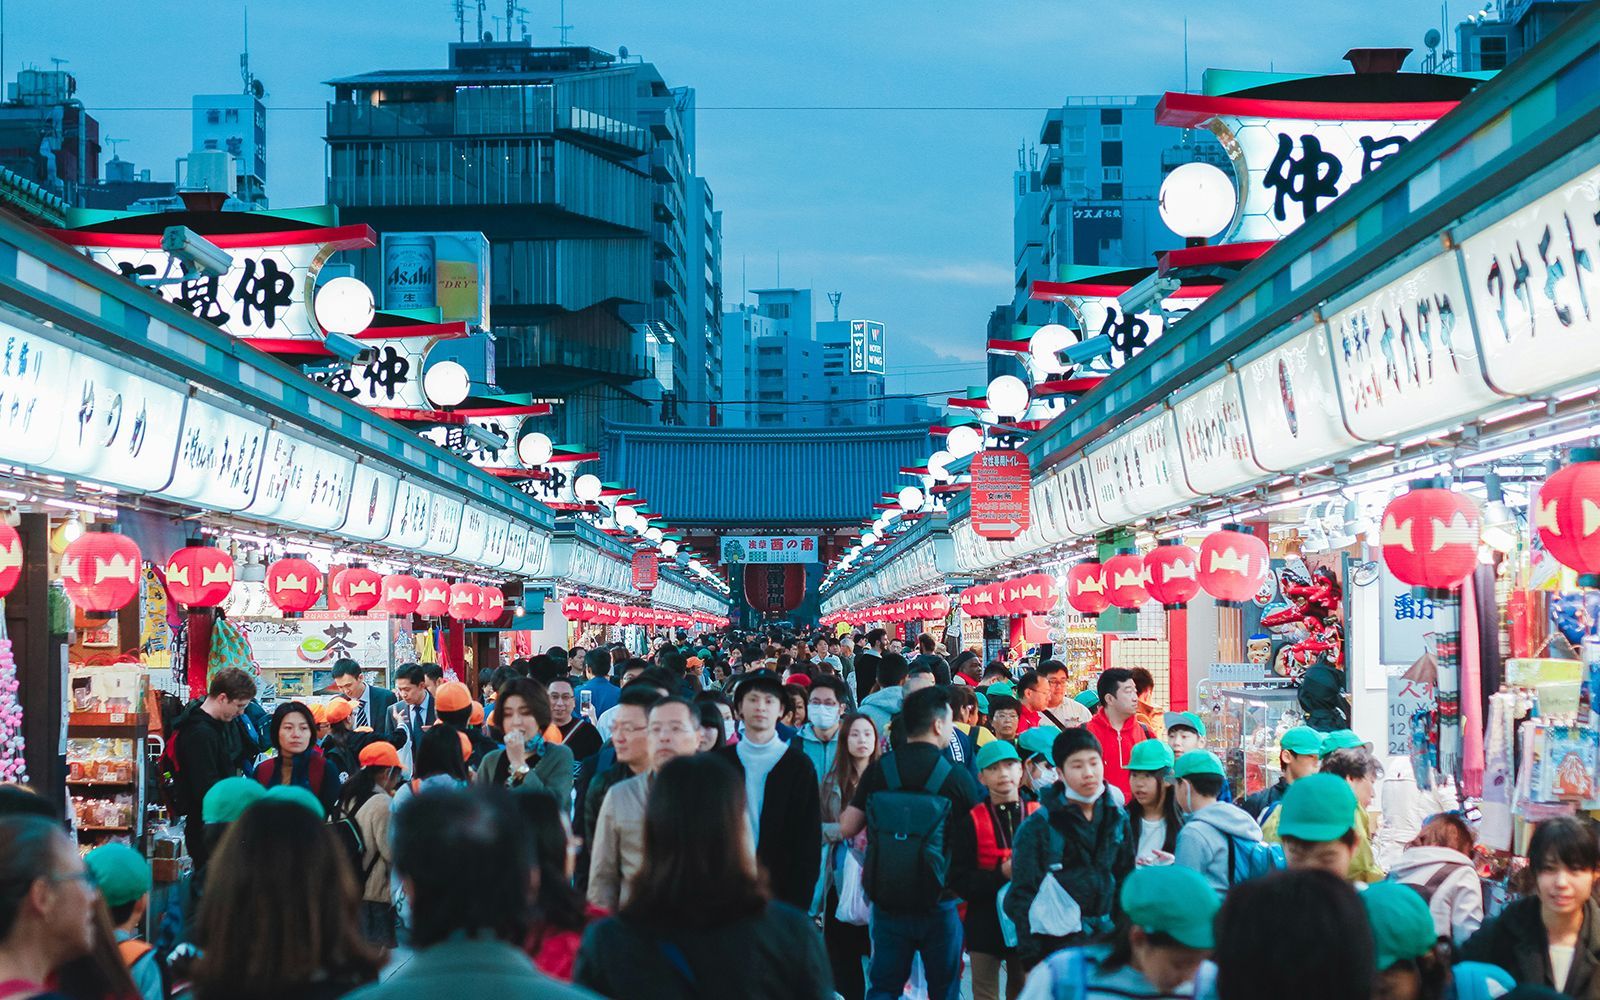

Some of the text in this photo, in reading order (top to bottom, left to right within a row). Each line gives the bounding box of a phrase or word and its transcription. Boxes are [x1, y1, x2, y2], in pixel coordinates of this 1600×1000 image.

[388, 266, 432, 285] Asahi
[403, 293, 416, 302] 生
[323, 622, 357, 659] 茶
[1390, 704, 1406, 716] 10
[1390, 723, 1406, 735] 12
[1389, 742, 1406, 754] 24
